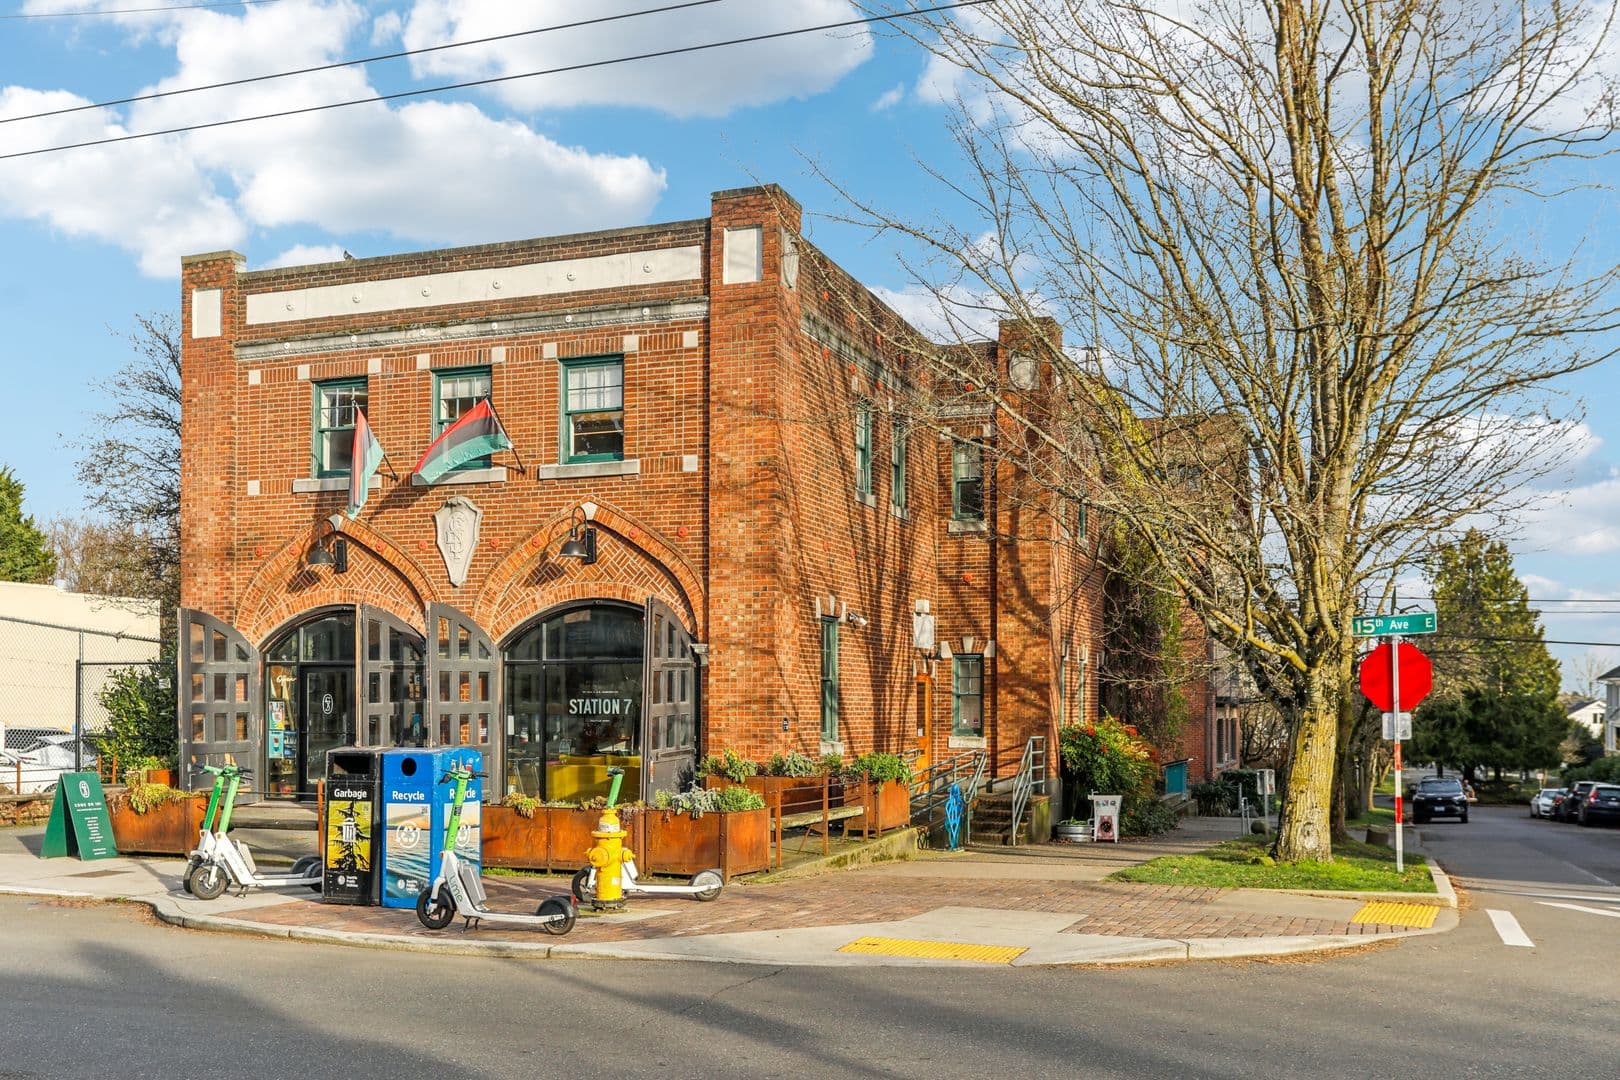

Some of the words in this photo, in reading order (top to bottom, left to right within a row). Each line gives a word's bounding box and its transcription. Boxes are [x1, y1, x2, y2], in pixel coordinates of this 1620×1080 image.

[1355, 619, 1384, 633] 15th
[1389, 619, 1409, 630] Ave
[1425, 617, 1433, 628] E
[569, 698, 620, 715] STATION
[623, 698, 633, 715] 7
[334, 788, 367, 799] Garbage
[392, 790, 425, 801] Recycle
[449, 787, 476, 799] Rycle
